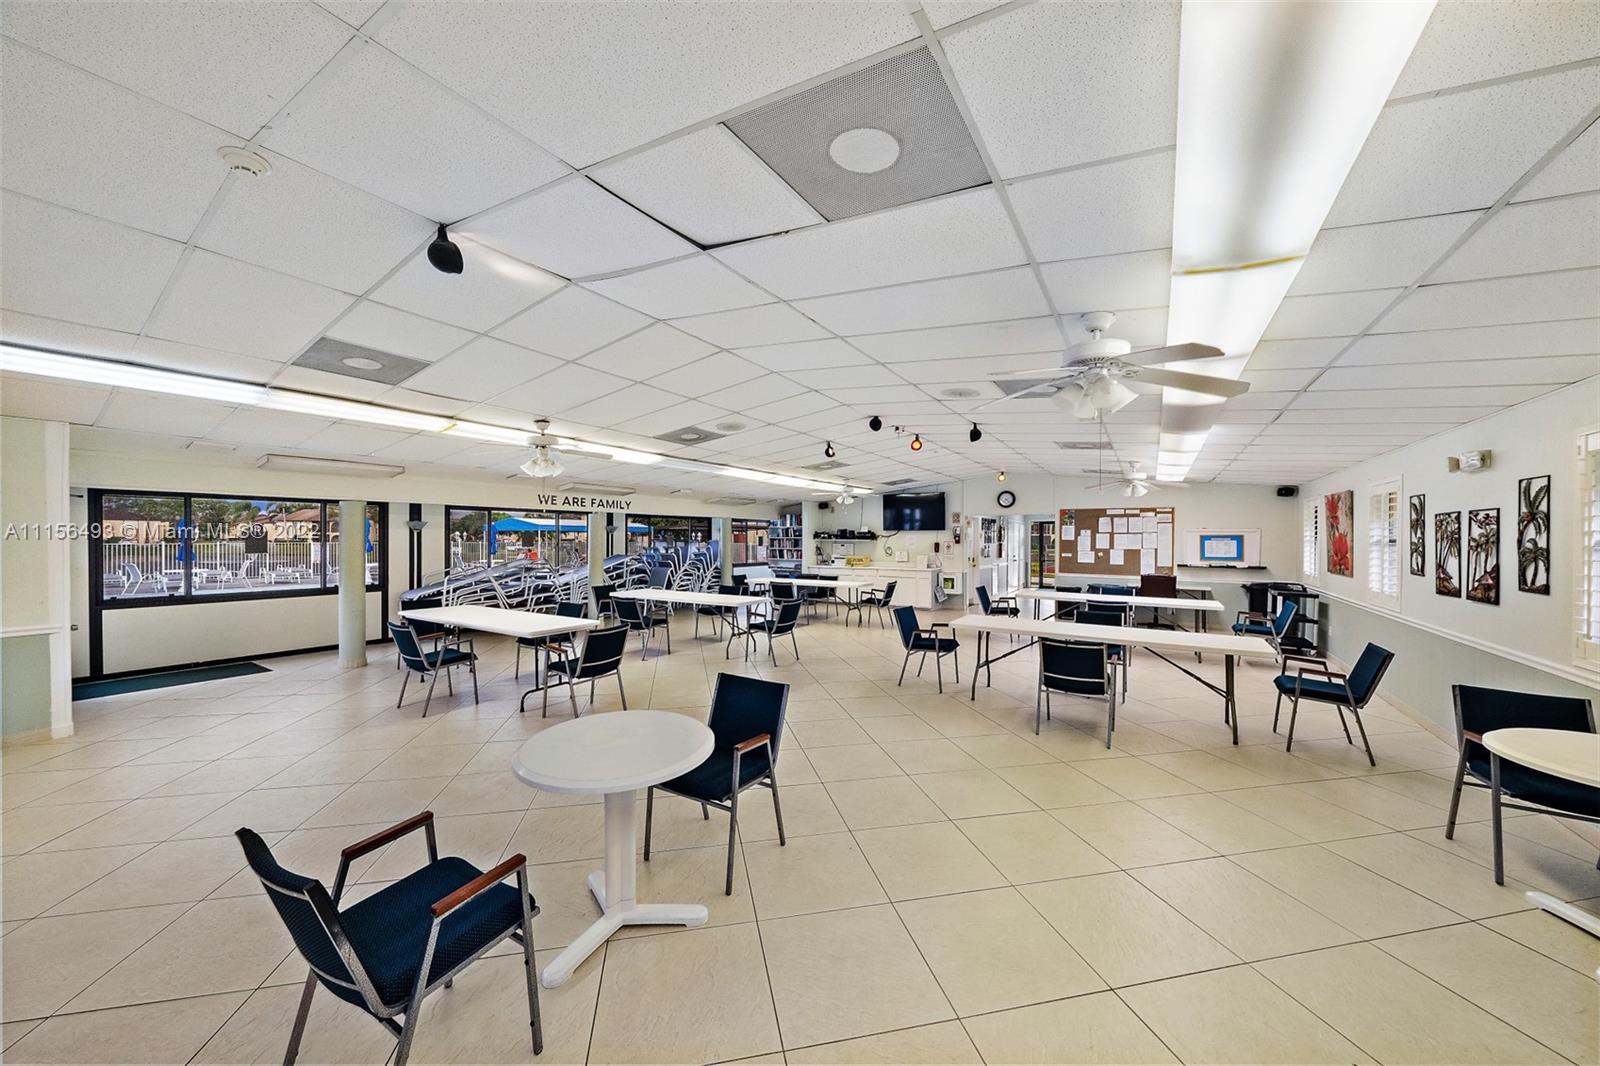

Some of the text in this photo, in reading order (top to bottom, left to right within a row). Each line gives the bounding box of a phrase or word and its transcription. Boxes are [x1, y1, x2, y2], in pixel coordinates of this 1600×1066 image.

[537, 494, 632, 510] WE ARE FAMILY
